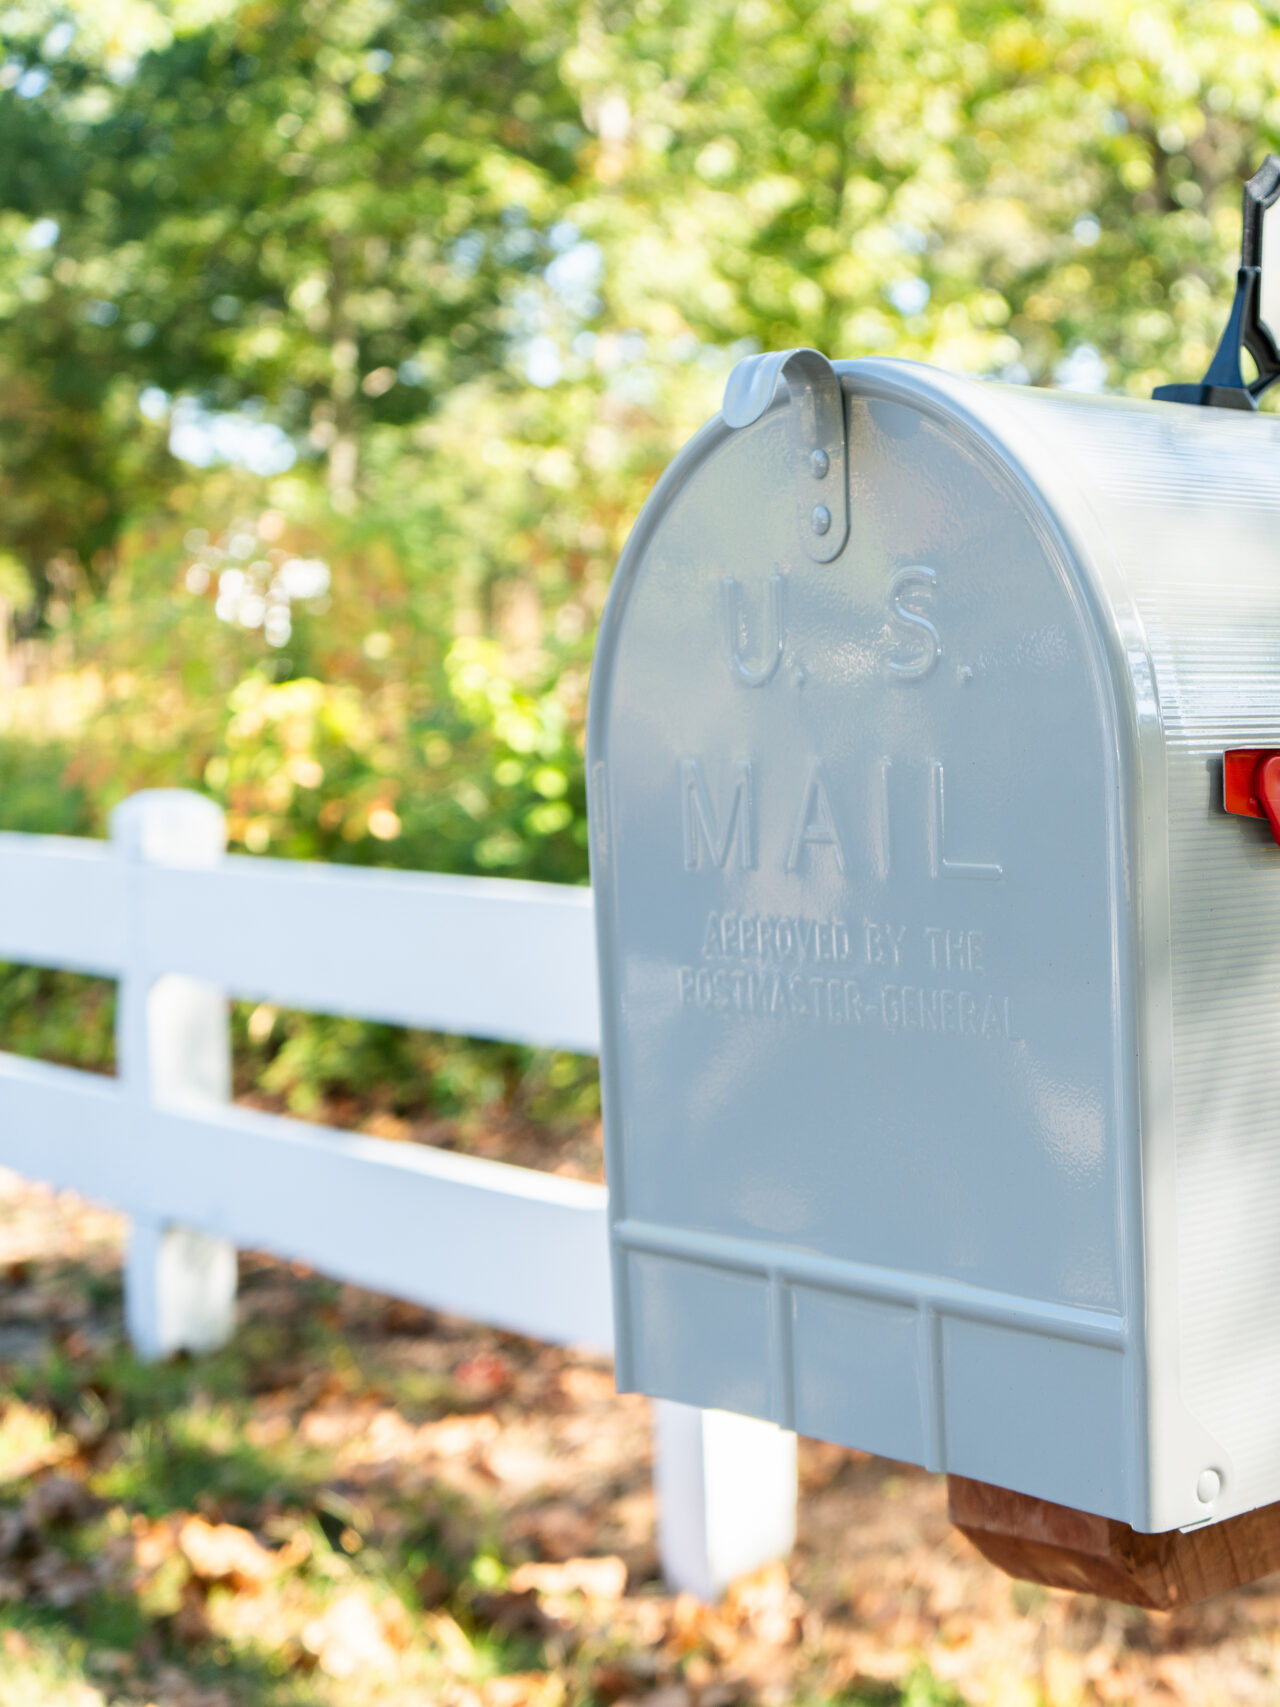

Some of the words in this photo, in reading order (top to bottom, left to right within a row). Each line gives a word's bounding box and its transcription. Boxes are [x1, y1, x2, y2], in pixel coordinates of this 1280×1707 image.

[719, 574, 806, 688] U.
[885, 564, 974, 687] S.
[679, 758, 1004, 881] MAIL
[701, 909, 850, 963] APPROVED
[864, 920, 906, 968] BY
[923, 925, 987, 976] THE
